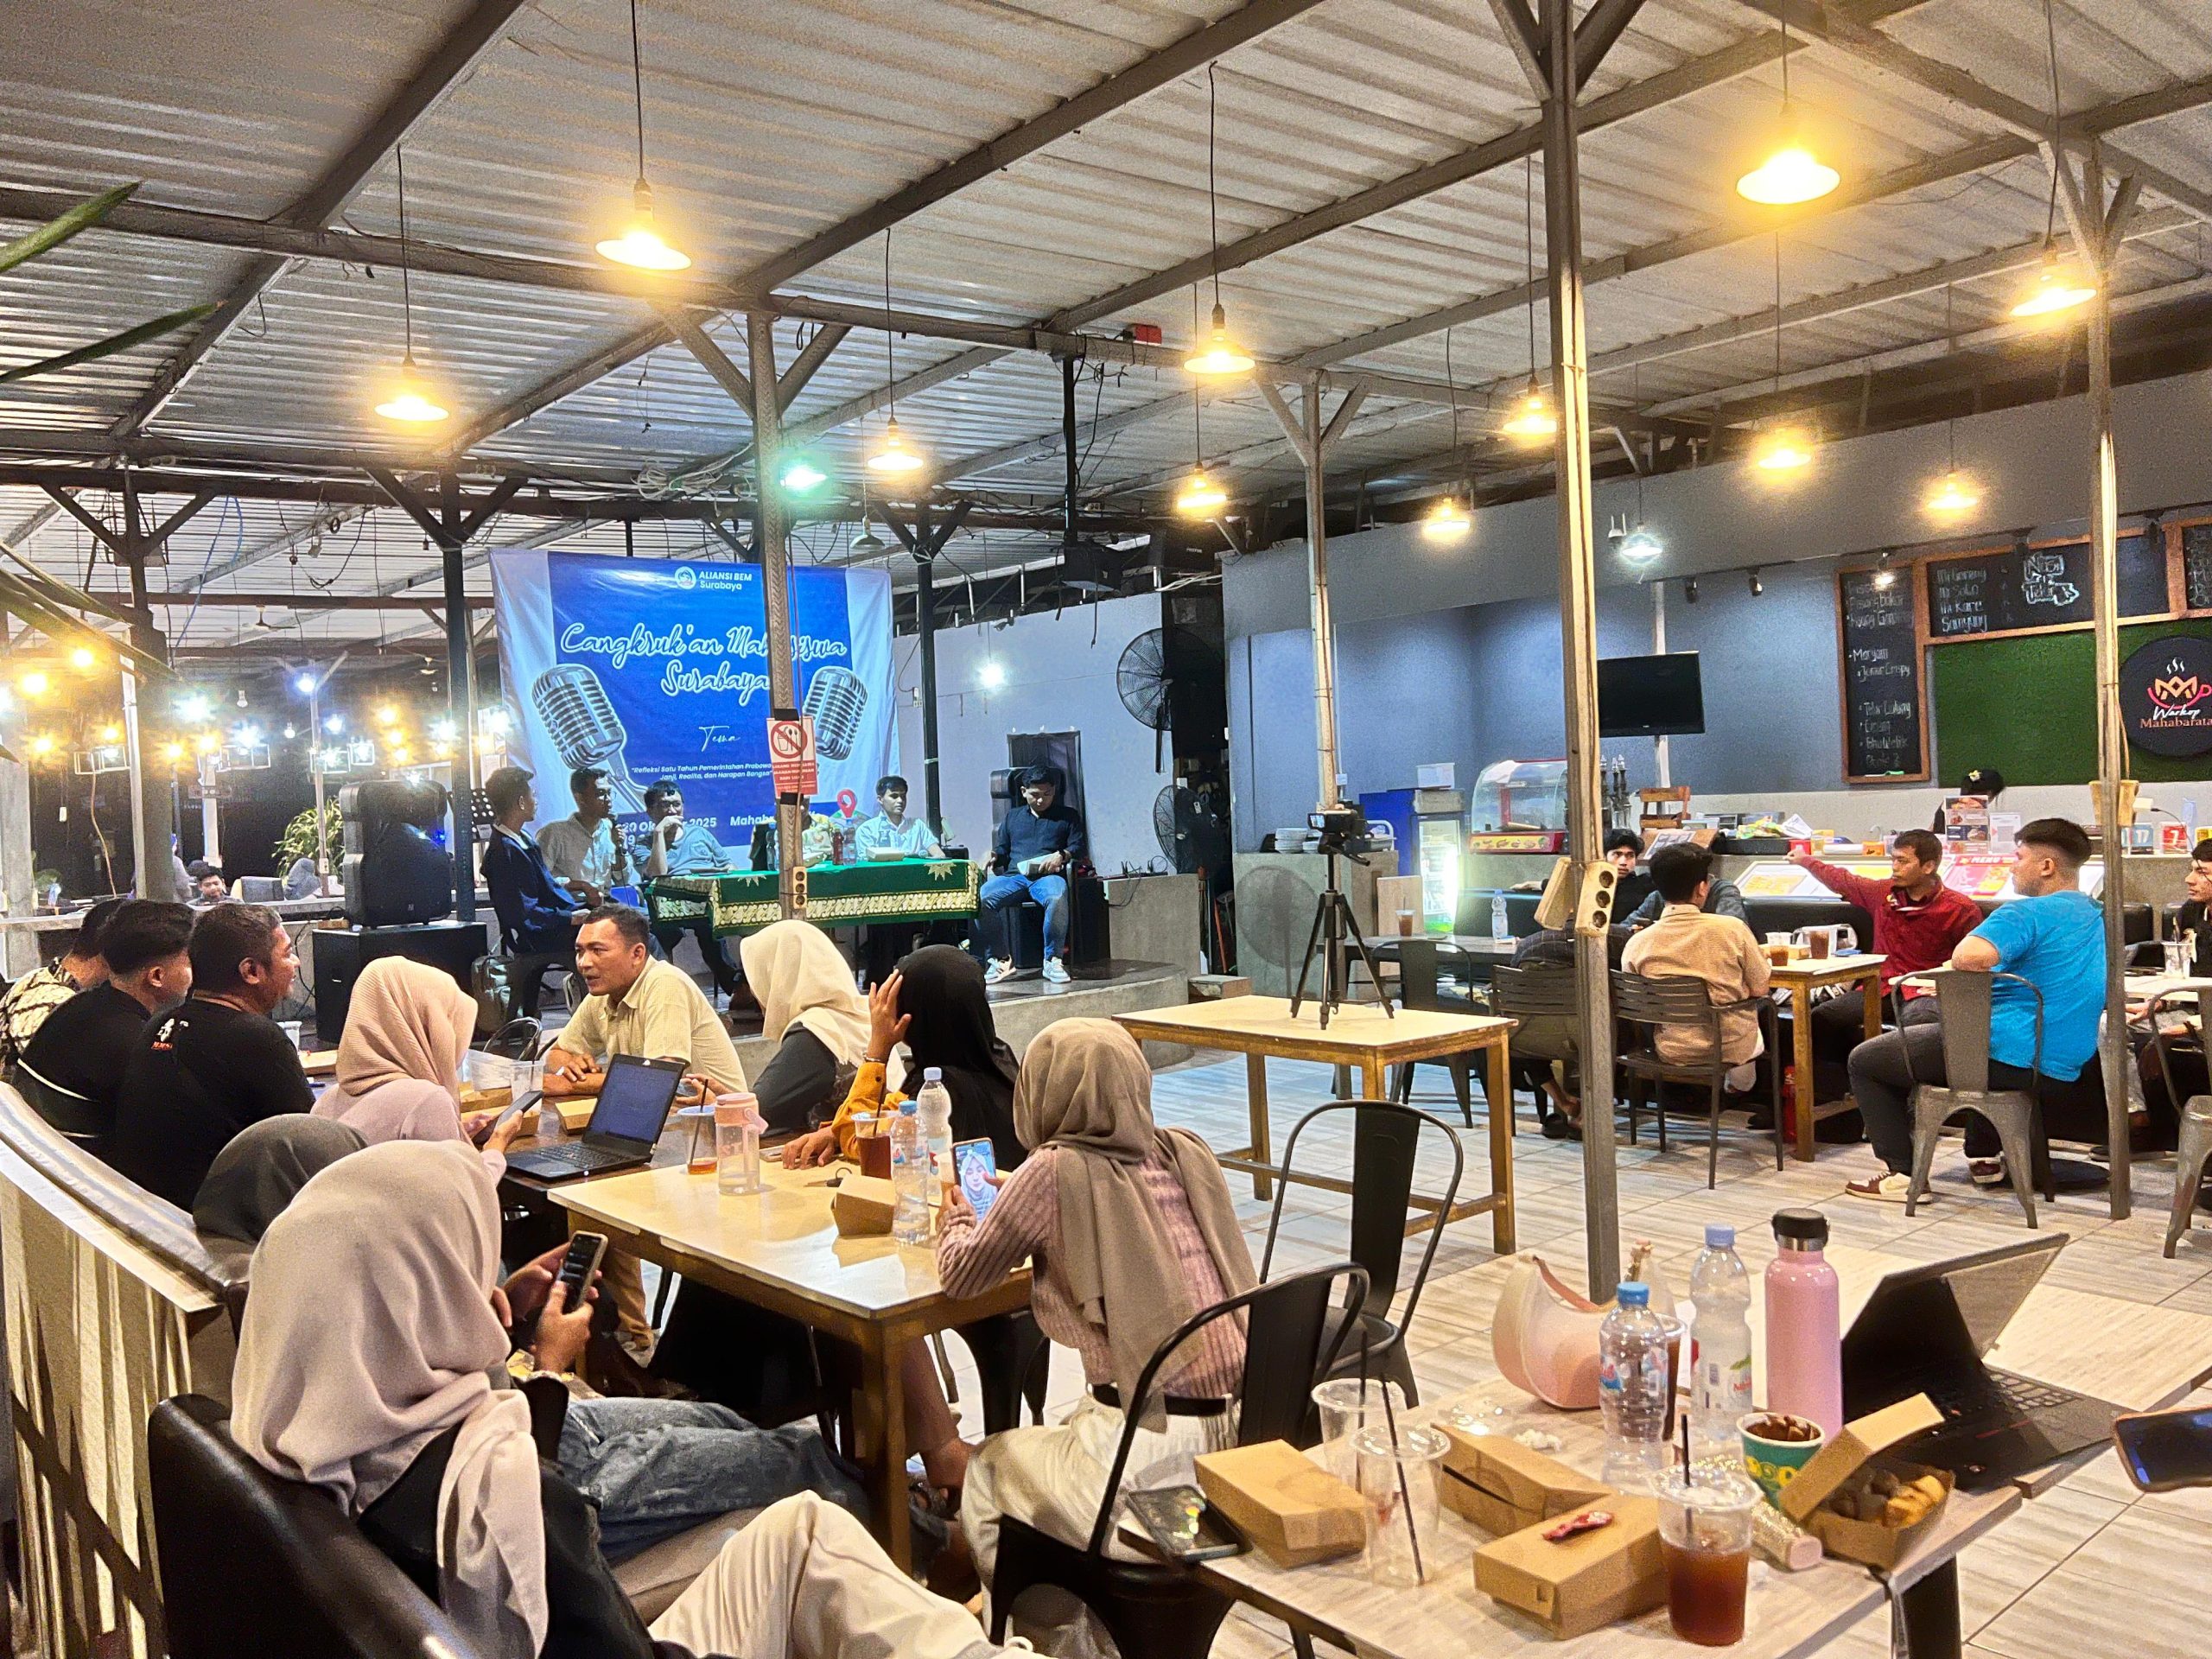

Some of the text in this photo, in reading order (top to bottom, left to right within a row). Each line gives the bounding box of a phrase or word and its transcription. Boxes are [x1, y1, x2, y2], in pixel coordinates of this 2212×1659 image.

[698, 570, 753, 582] ALIANSI BEM
[699, 581, 742, 592] Surabaya
[560, 622, 724, 670] Cangkruk'an
[660, 658, 770, 707] Surabaya
[2152, 704, 2202, 721] Warkop
[2140, 717, 2212, 728] Mahabarata
[698, 725, 741, 753] Tema
[698, 763, 744, 772] Pemerintahan
[689, 817, 717, 828] 2025
[2135, 830, 2150, 844] 17
[2170, 830, 2179, 845] 7
